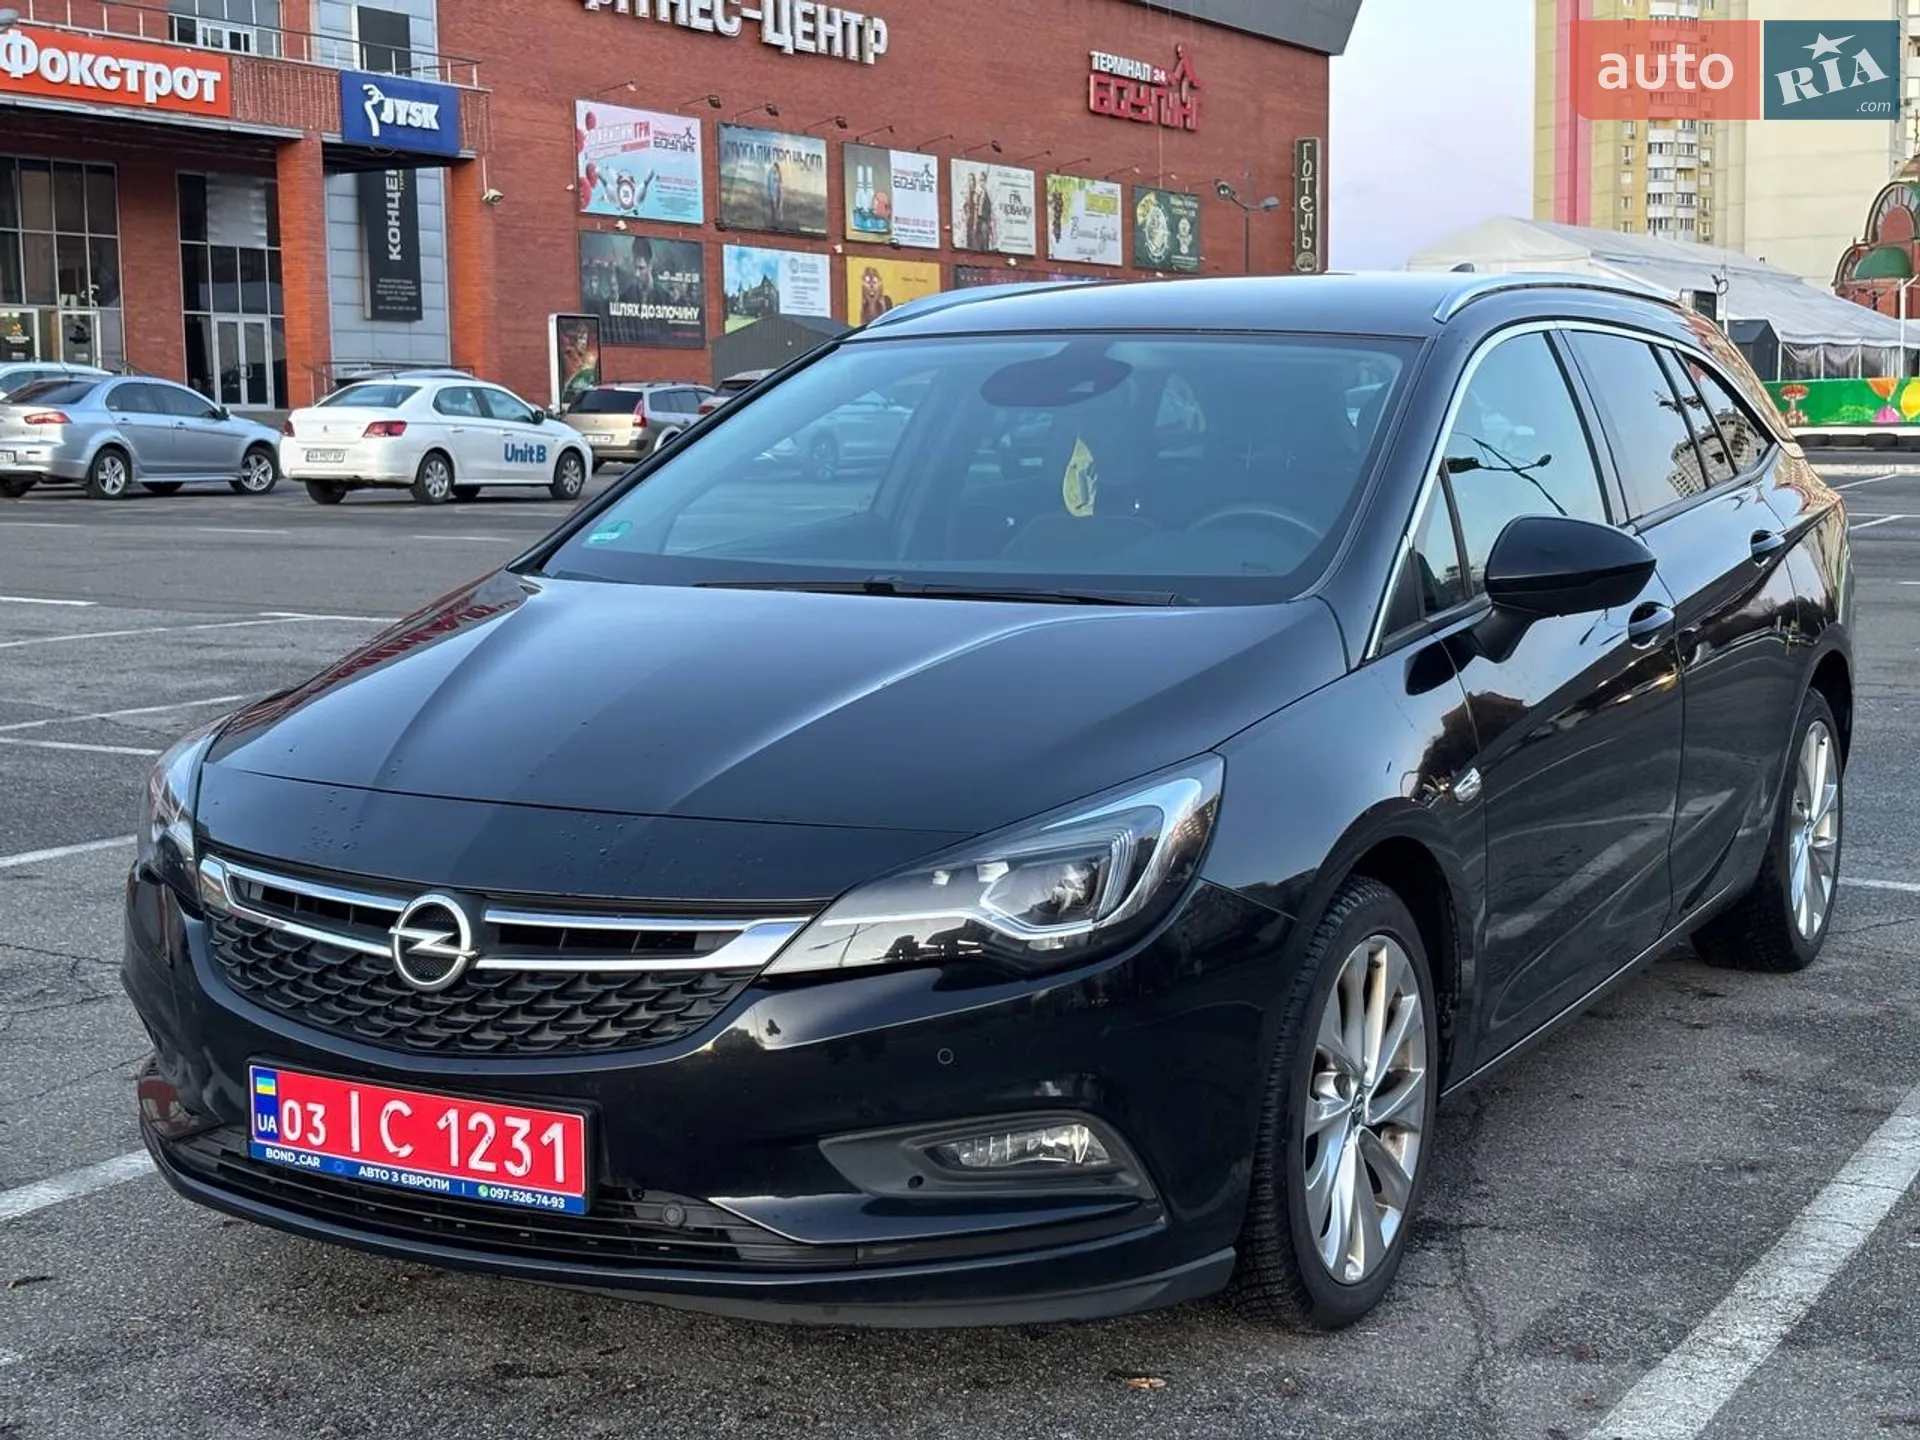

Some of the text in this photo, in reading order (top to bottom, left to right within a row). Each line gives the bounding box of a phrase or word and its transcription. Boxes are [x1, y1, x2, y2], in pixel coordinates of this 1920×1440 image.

[1090, 51, 1166, 83] ТЕРМІНАЛ 24
[380, 97, 440, 130] JYSK
[609, 302, 700, 321] ШЛЯХ ДО ЗЛОЧИНУ
[257, 1113, 277, 1134] UA
[282, 1099, 327, 1146] 03
[436, 1107, 565, 1184] 1231
[265, 1147, 321, 1168] BOND_CAR
[358, 1165, 389, 1182] АВТО
[400, 1171, 450, 1191] ЄВРОПИ
[489, 1187, 566, 1209] 097-526-74-93
